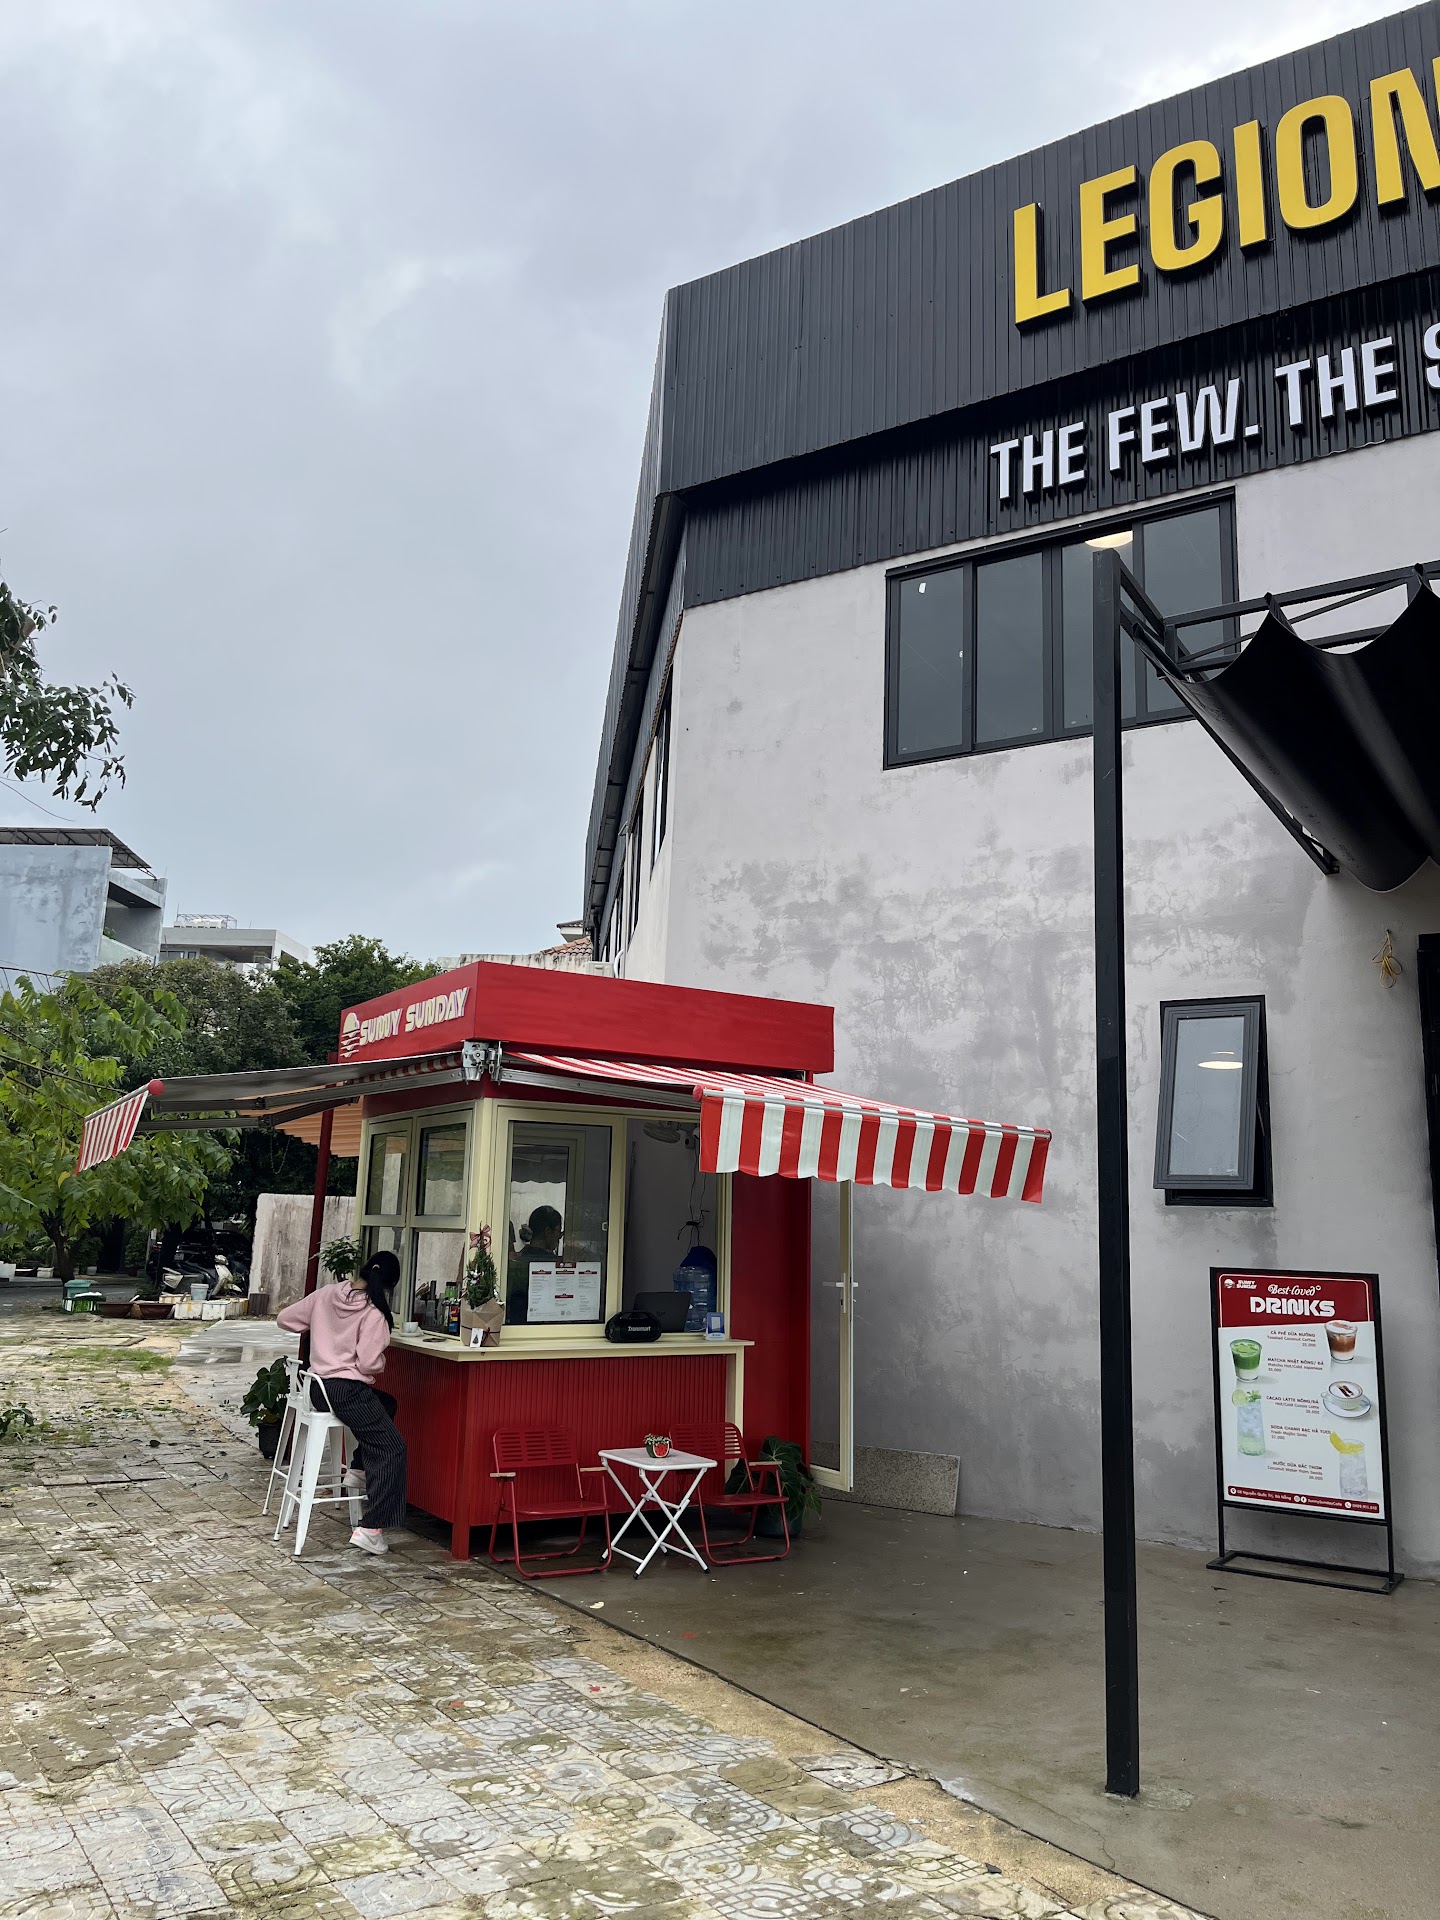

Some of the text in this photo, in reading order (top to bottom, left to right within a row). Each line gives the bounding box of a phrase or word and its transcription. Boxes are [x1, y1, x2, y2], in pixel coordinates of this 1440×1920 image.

[990, 421, 1087, 500] THE
[1108, 378, 1260, 471] FEW.
[1274, 336, 1398, 427] THE
[359, 987, 470, 1046] SUNNY SUNDAY
[1250, 1297, 1335, 1317] DRINKS
